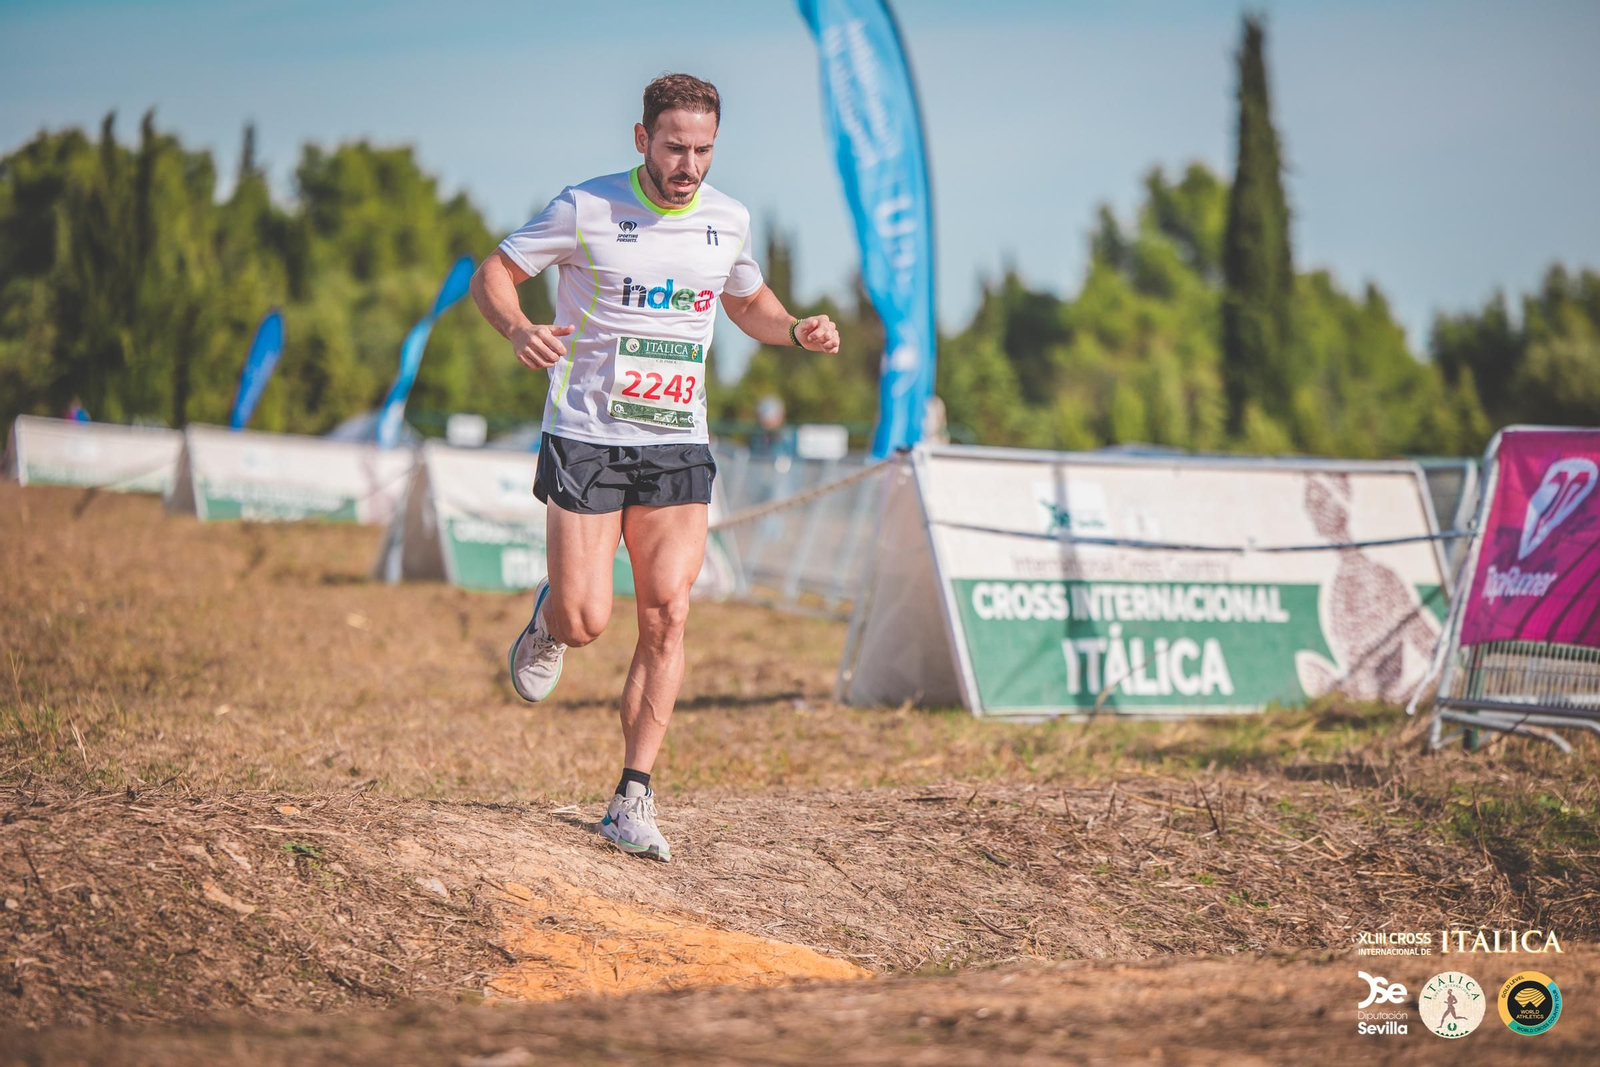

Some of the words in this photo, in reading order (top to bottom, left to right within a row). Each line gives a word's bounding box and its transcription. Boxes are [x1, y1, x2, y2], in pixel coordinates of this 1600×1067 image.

[621, 276, 715, 312] indea
[645, 340, 689, 356] ITÁLICA
[621, 369, 697, 405] 2243
[971, 582, 1070, 621] CROSS
[1070, 583, 1290, 624] INTERNACIONAL
